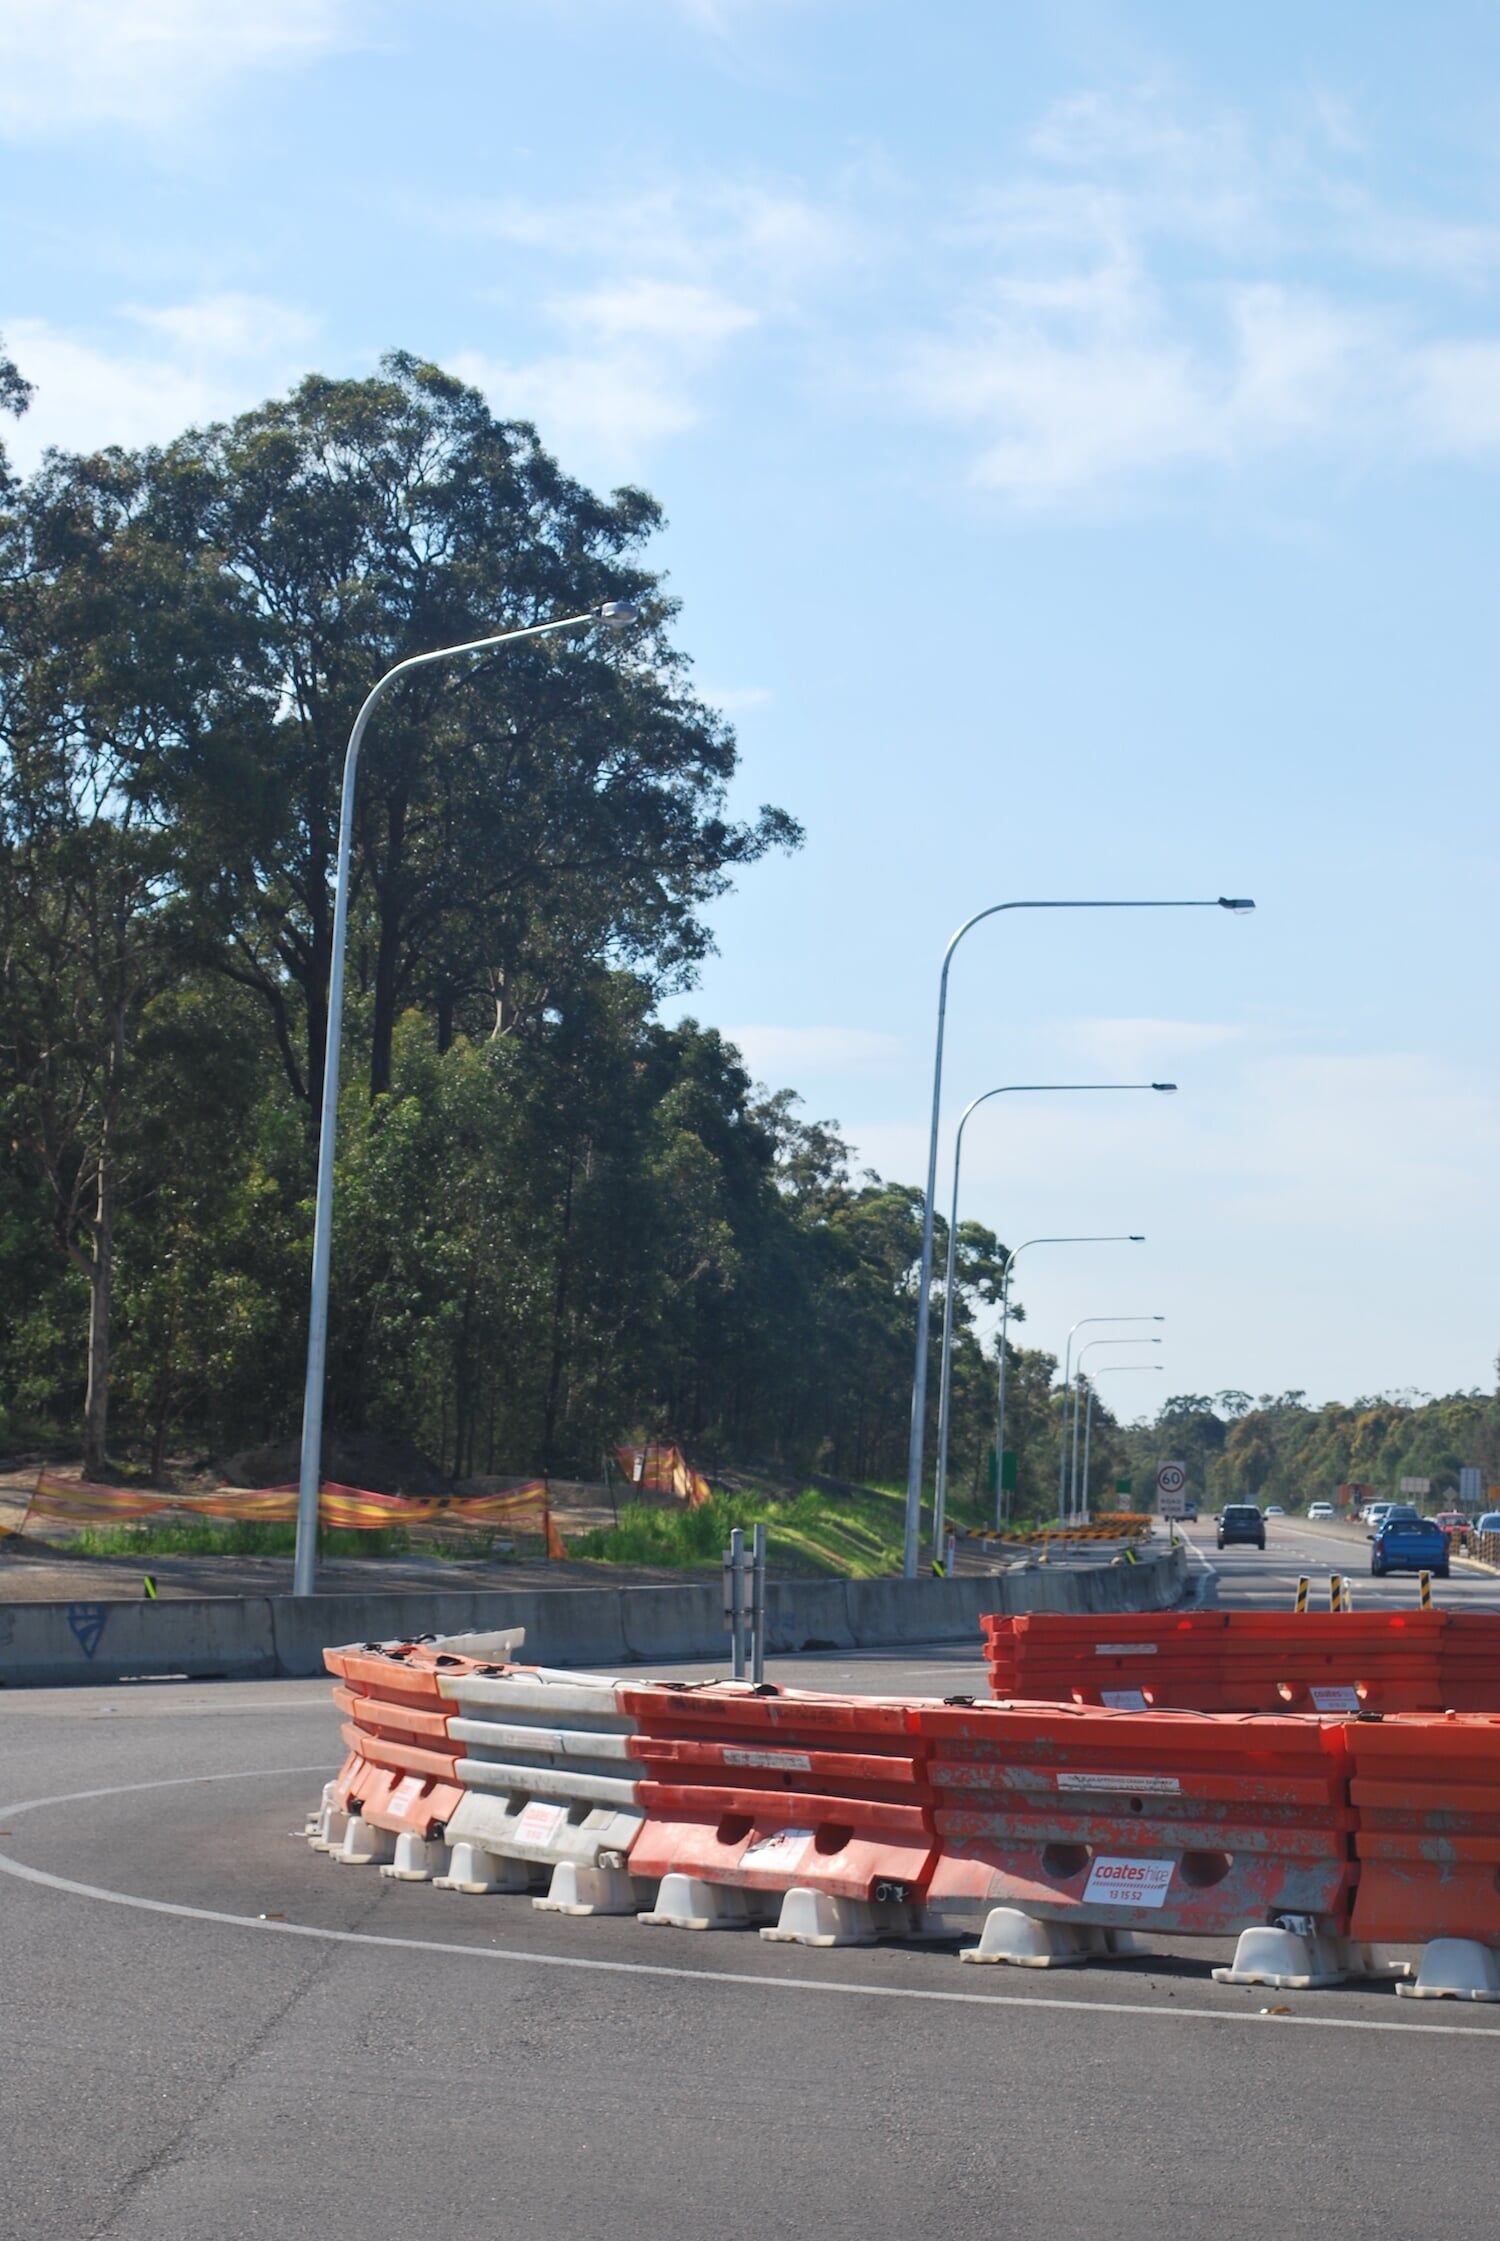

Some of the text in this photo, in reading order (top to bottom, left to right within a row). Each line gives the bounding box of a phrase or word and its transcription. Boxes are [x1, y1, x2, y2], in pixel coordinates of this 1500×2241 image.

[1162, 1472, 1180, 1485] 60
[1109, 1890, 1142, 1900] 13 15 52
